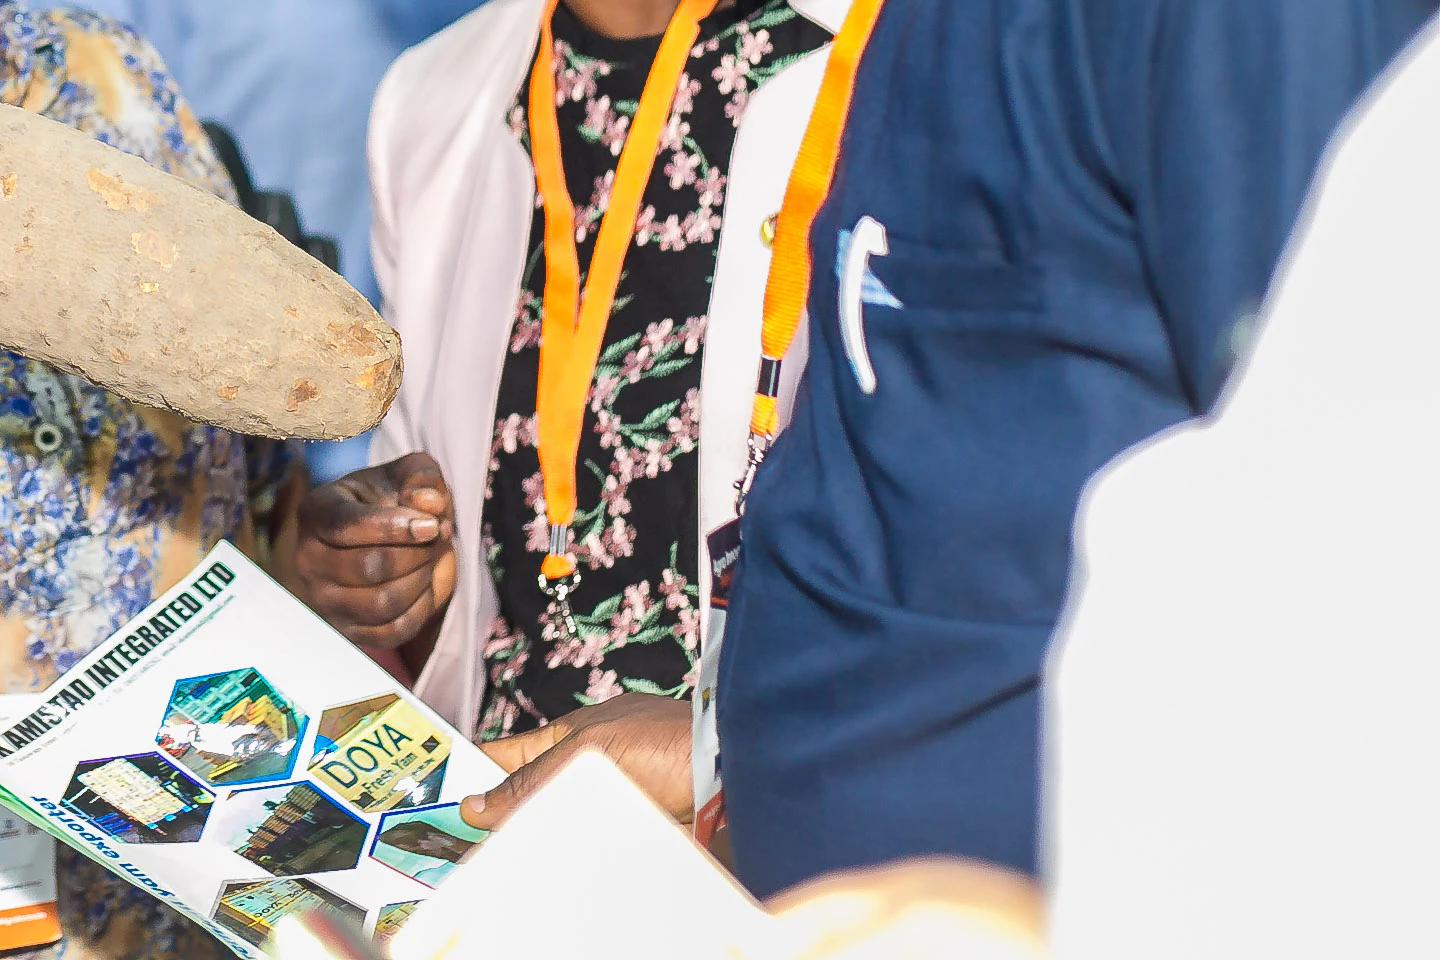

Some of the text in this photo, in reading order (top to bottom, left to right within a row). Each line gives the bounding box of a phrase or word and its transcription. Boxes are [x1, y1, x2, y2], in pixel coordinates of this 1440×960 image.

[1, 677, 96, 751] AMISTAD
[84, 591, 204, 690] INTEGRATED
[190, 560, 236, 601] LTD
[320, 723, 413, 789] DOYA
[361, 769, 395, 794] Fresh
[391, 752, 418, 770] Yam
[30, 796, 176, 897] yam exporter
